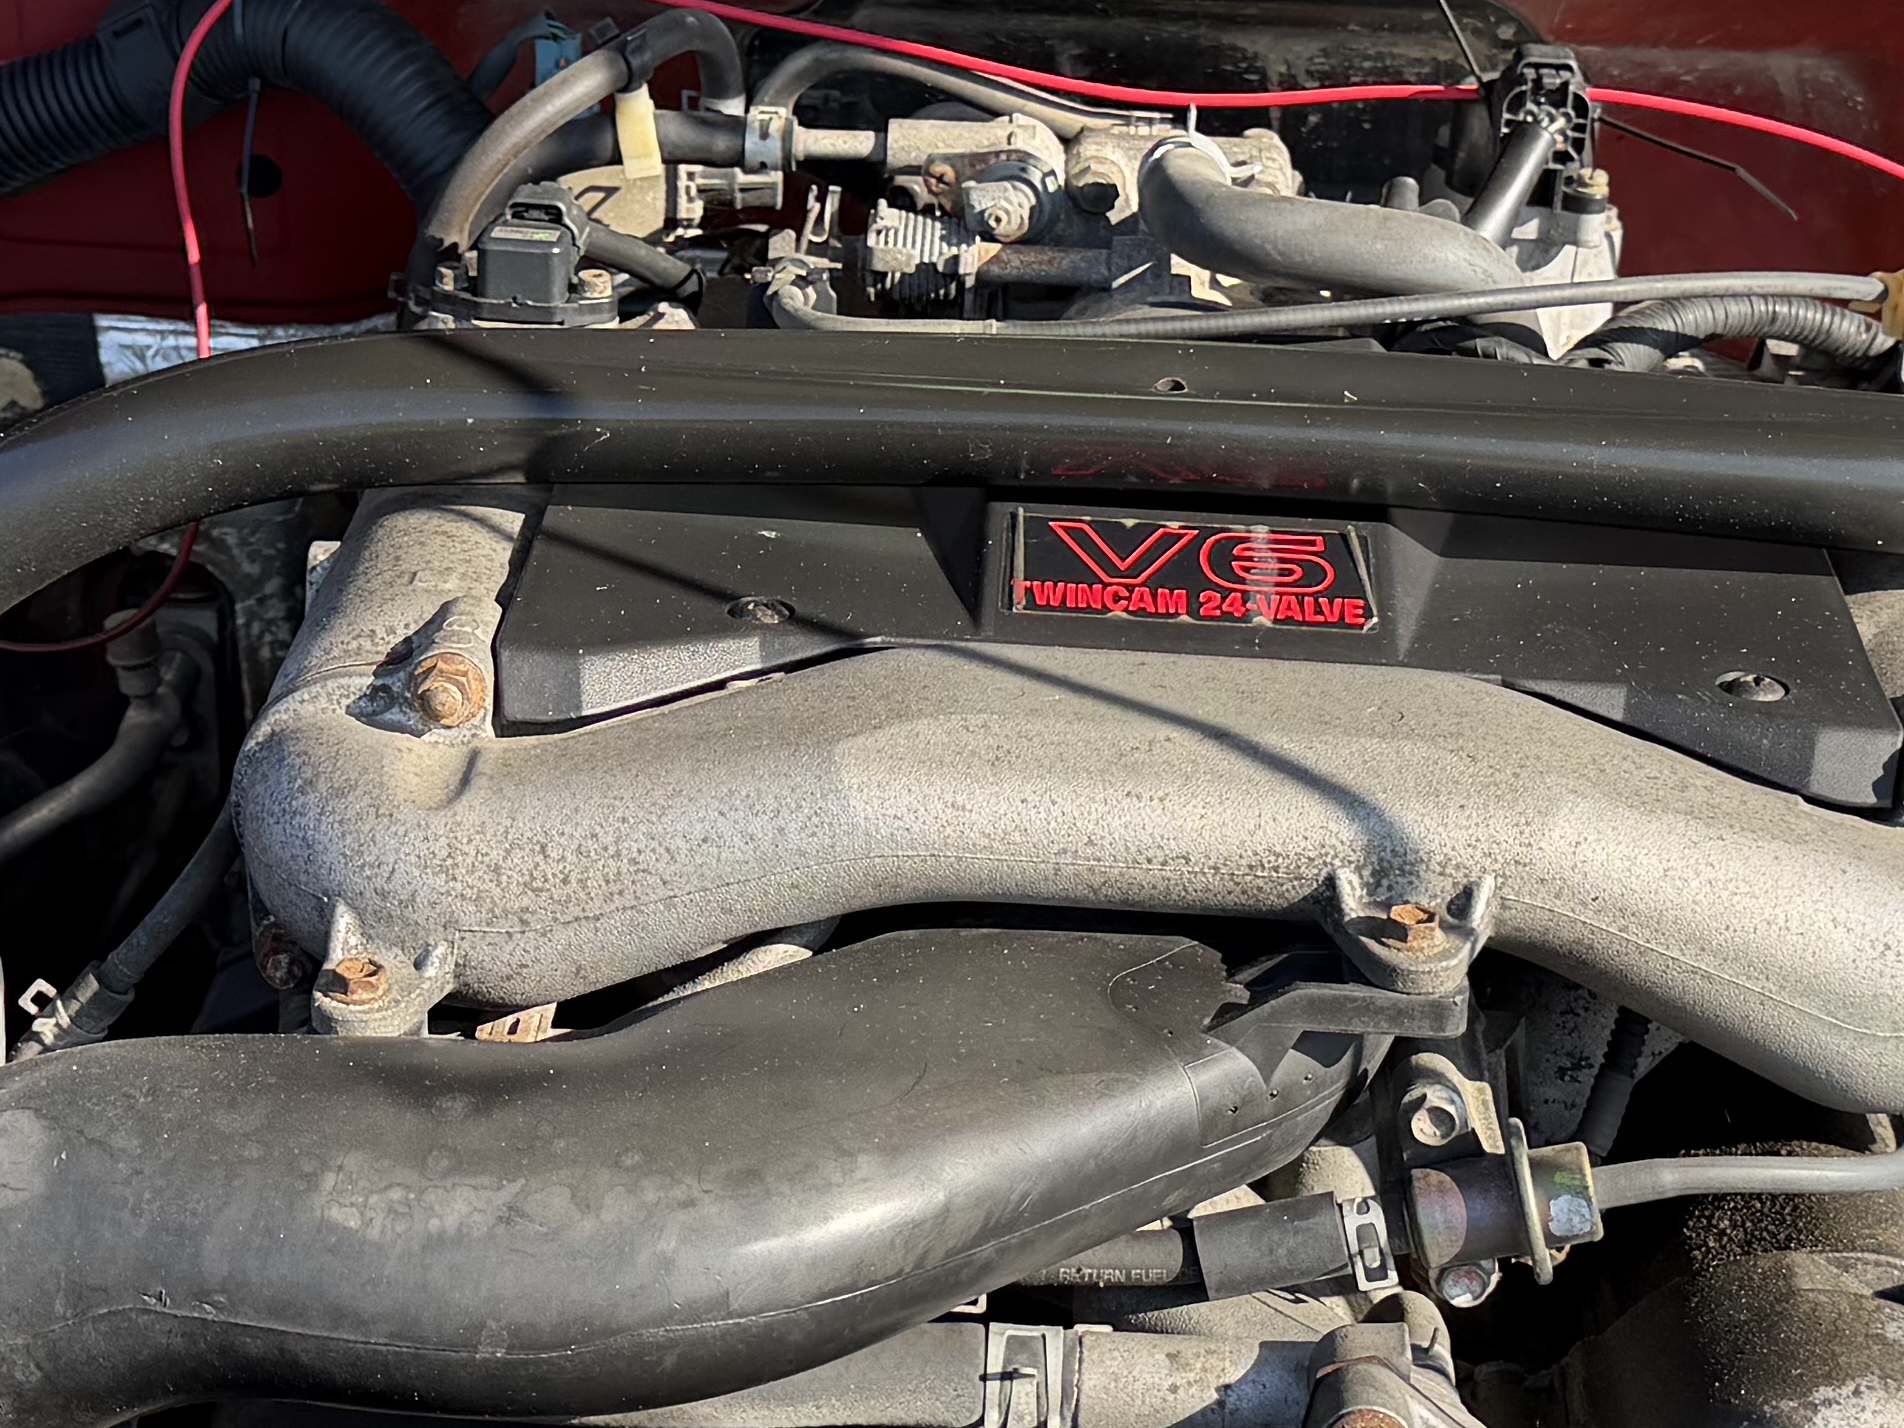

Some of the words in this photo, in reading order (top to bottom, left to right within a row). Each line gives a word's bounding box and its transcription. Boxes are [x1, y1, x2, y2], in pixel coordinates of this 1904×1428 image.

[1049, 521, 1335, 593] V6
[1010, 578, 1188, 616] TWINCAM
[1199, 590, 1366, 626] 24-VALVE
[1059, 1266, 1127, 1283] RETURN
[1130, 1269, 1170, 1283] FUEL
